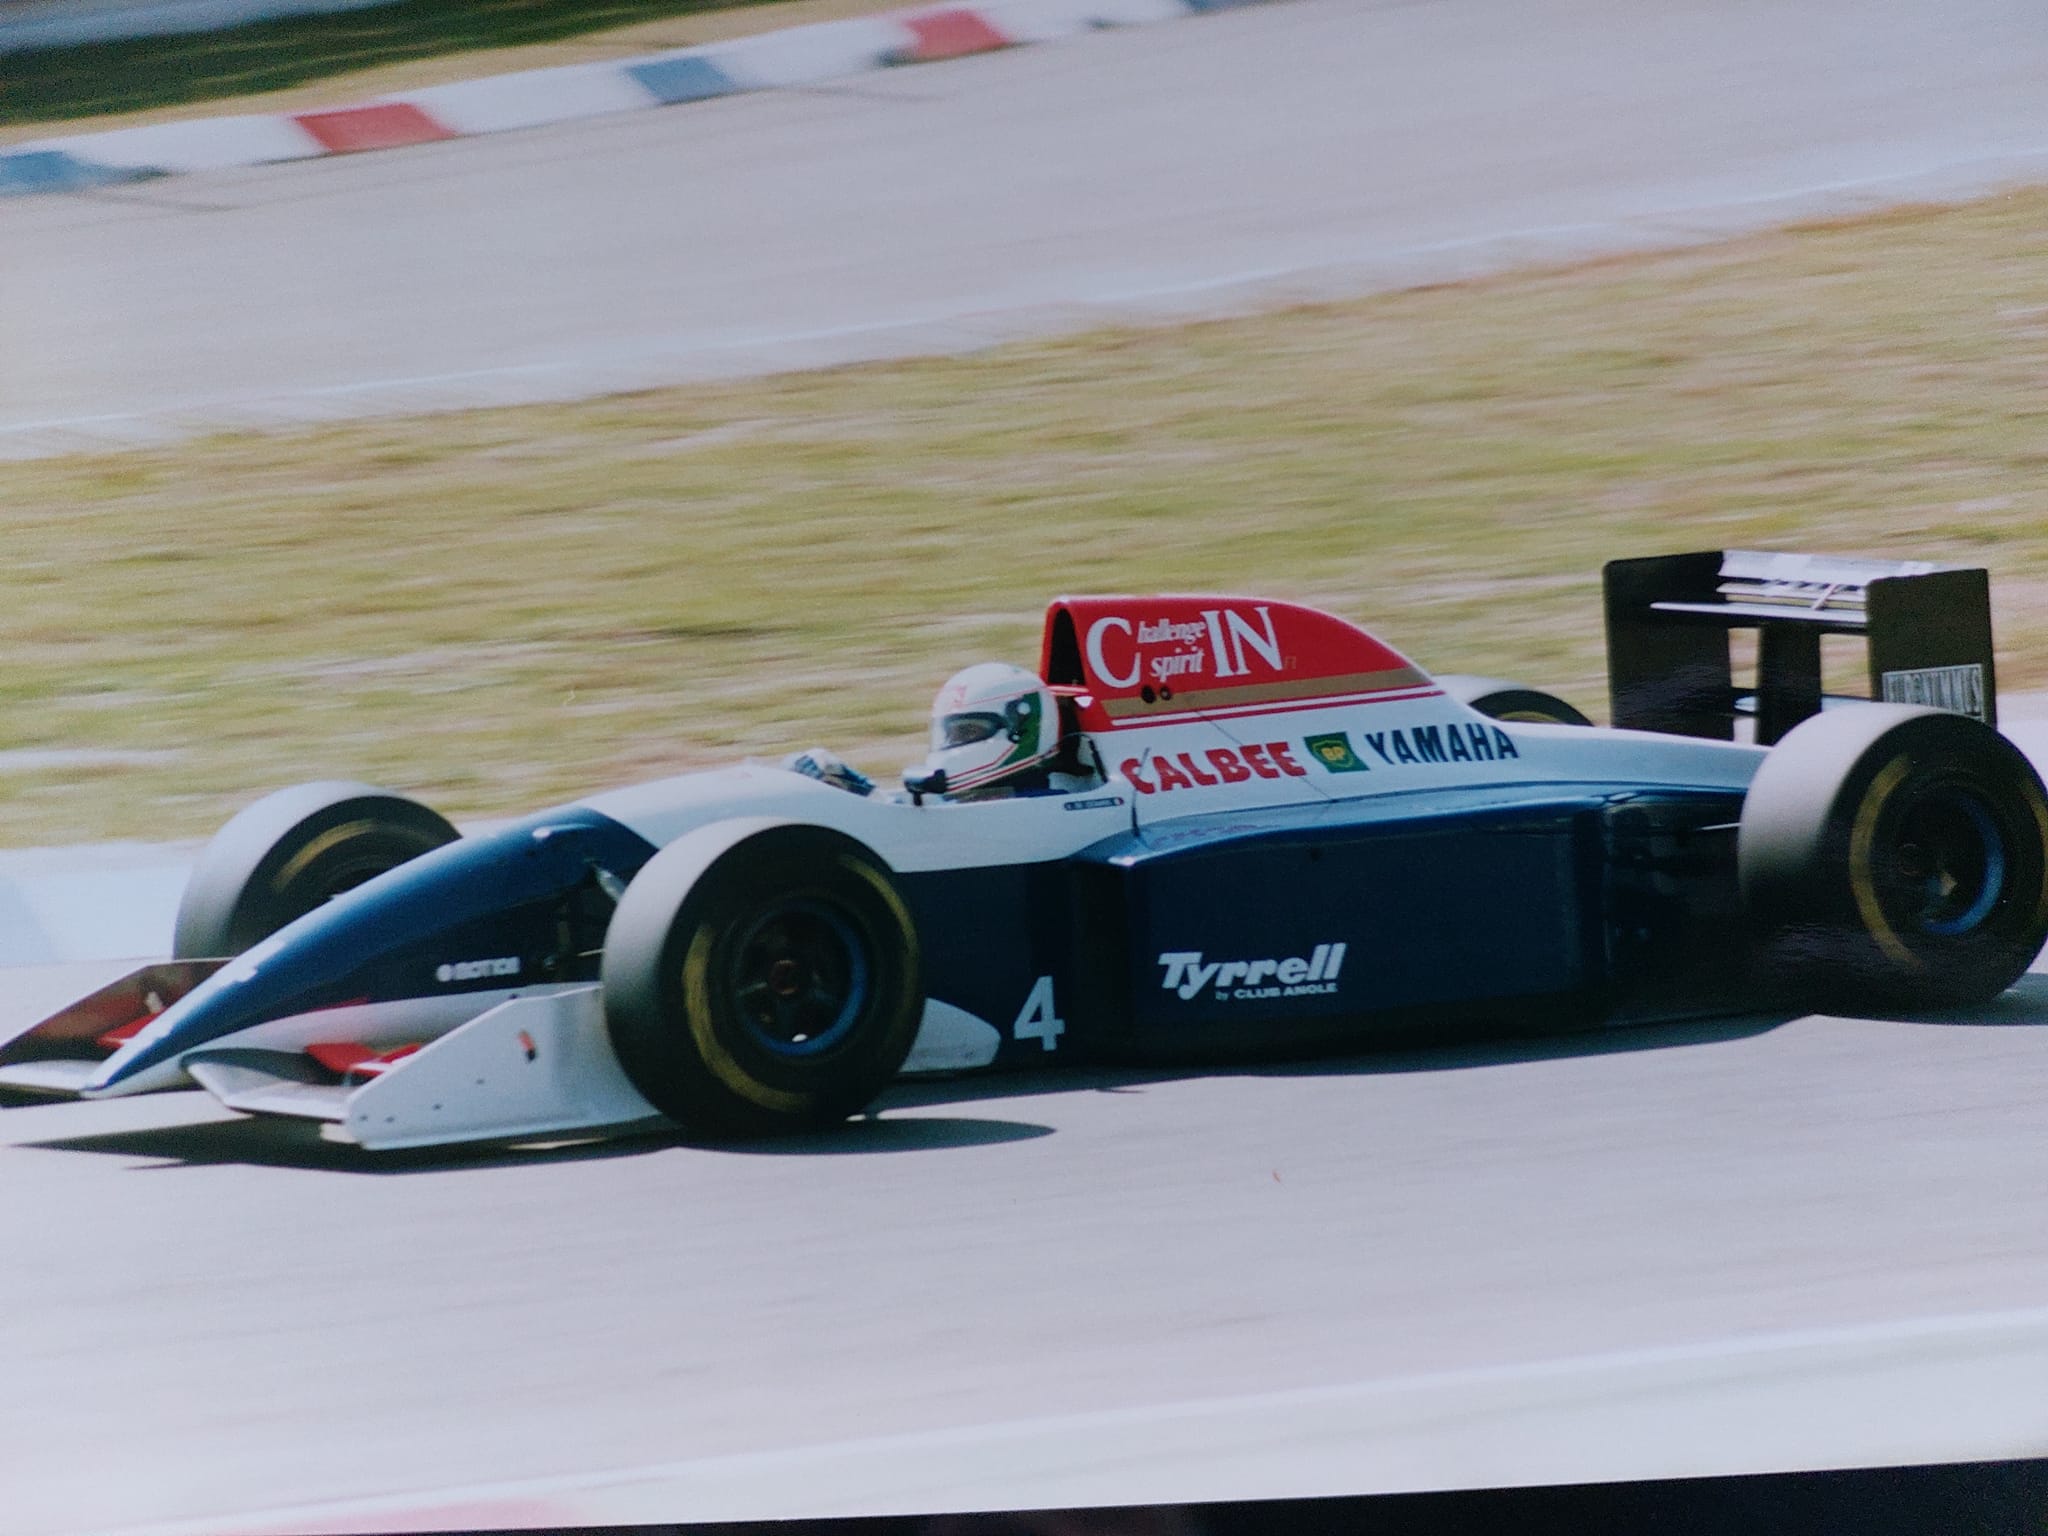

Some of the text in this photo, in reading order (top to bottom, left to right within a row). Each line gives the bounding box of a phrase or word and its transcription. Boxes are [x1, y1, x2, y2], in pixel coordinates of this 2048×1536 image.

[1149, 646, 1204, 683] spirit
[1200, 606, 1283, 677] IN
[1120, 741, 1307, 794] CALBEE
[1364, 723, 1519, 765] YAMAHA
[1157, 942, 1347, 1000] Tyrrell
[1234, 987, 1281, 999] CLUB
[1013, 975, 1065, 1050] 4
